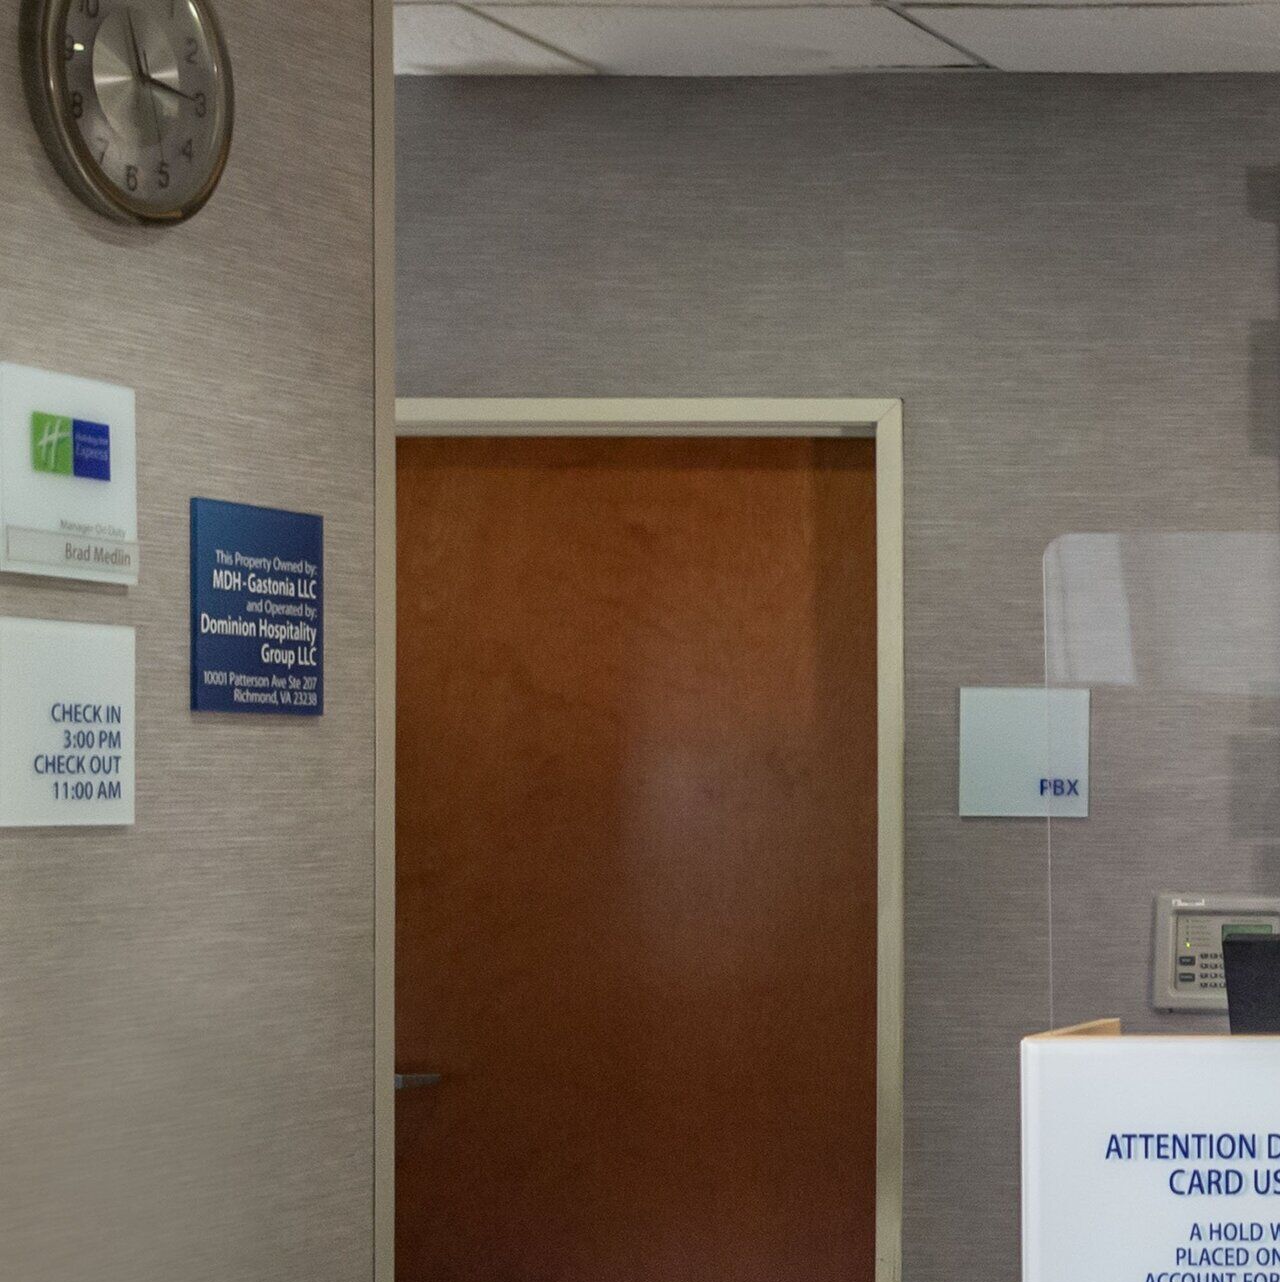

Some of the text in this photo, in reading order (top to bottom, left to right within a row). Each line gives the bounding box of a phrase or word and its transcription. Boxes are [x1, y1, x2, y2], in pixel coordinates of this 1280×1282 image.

[71, 92, 83, 118] 8
[97, 138, 109, 164] 7
[181, 139, 193, 162] 4
[125, 165, 138, 191] 6
[158, 162, 170, 188] 5
[65, 542, 90, 561] Brad
[216, 549, 317, 576] This Property Owned by:
[298, 579, 316, 599] LLC
[247, 600, 317, 619] and Operated by:
[201, 613, 316, 645] Dominion Hospitality
[261, 644, 316, 669] Group LLC
[204, 670, 317, 690] 10001 Patterson Ave Ste 207
[234, 688, 279, 705] Richmond,
[280, 690, 292, 704] VA
[51, 703, 121, 723] CHECK IN
[63, 730, 121, 749] 3:00 PM
[34, 754, 121, 774] CHECK OUT
[53, 781, 121, 800] 11:00 AM
[1039, 778, 1079, 796] PBX
[1105, 1133, 1257, 1160] ATTENTION
[1169, 1169, 1243, 1195] CARD
[1190, 1222, 1202, 1241] A
[1209, 1222, 1263, 1241] HOLD
[1176, 1248, 1249, 1266] PLACED
